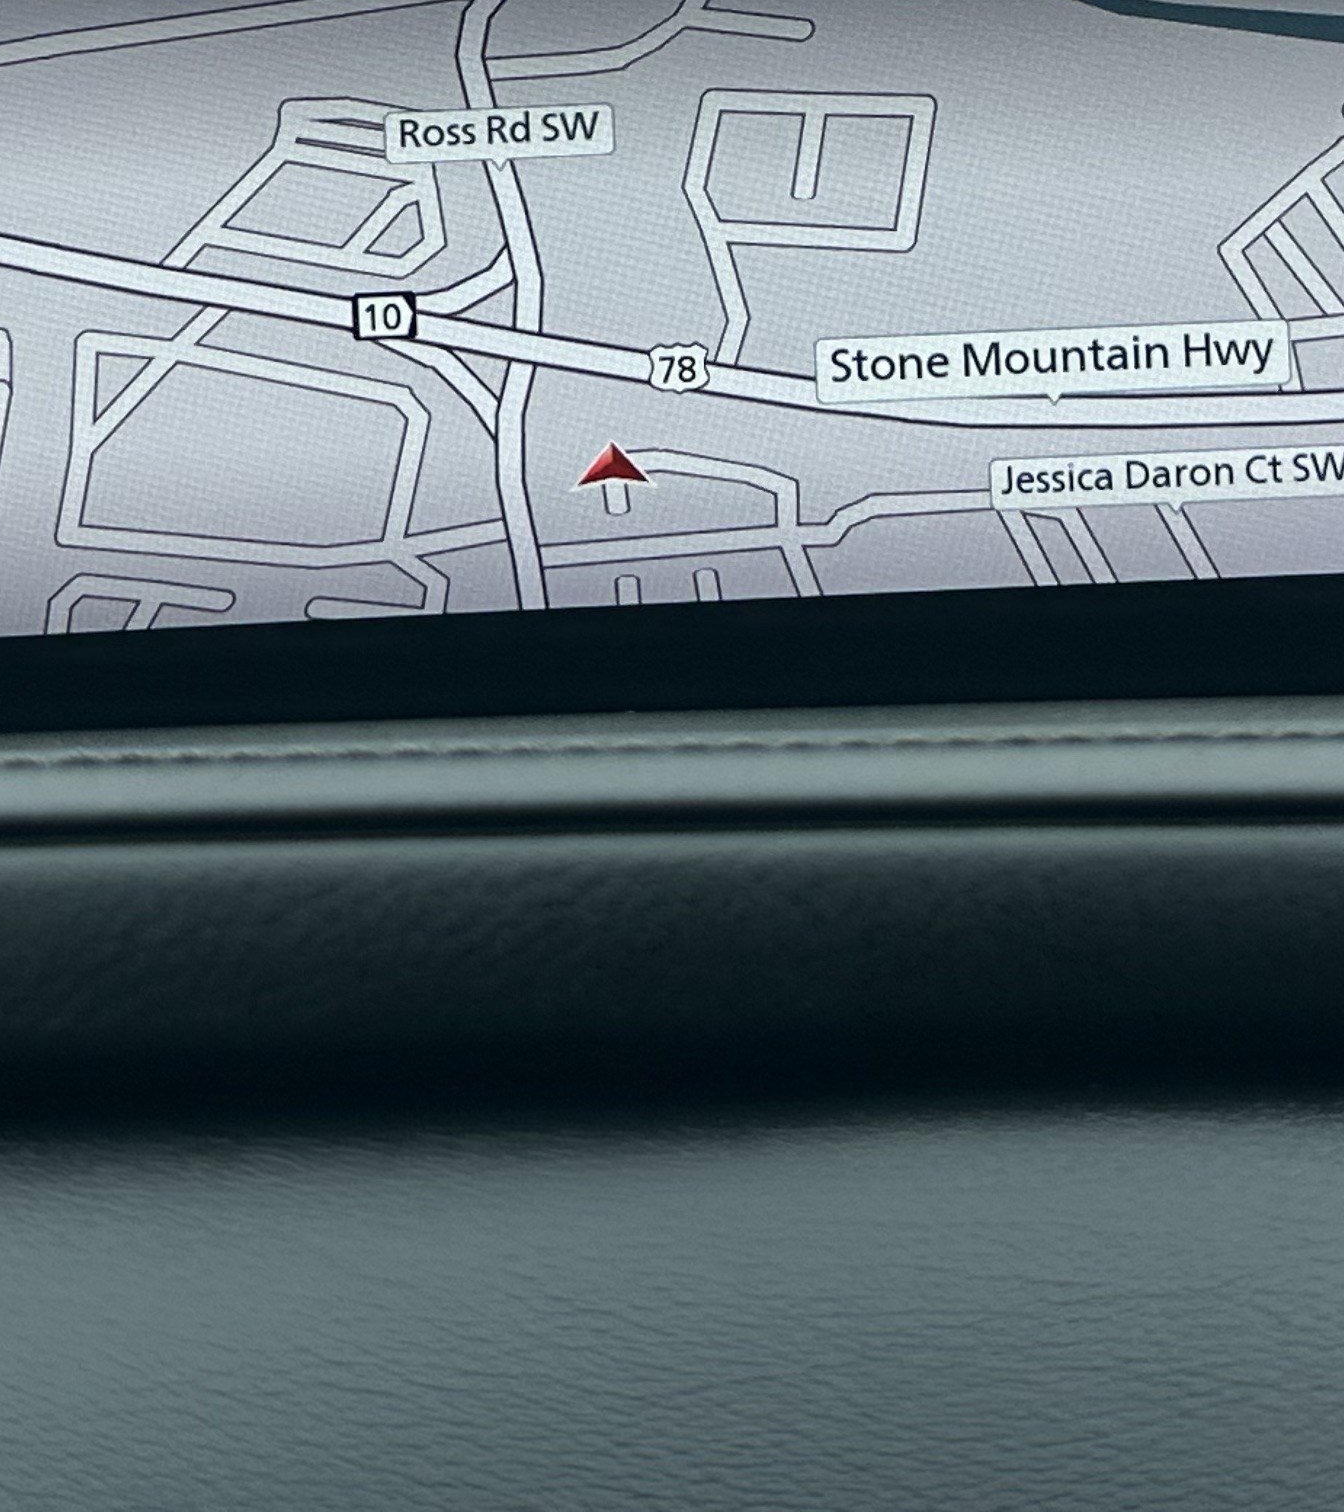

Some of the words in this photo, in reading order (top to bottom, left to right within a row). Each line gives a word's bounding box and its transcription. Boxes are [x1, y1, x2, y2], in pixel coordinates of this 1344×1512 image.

[399, 118, 476, 148] Ross
[486, 110, 531, 145] Rd
[542, 111, 599, 141] SW
[364, 303, 401, 331] 10
[657, 355, 697, 383] 78
[831, 347, 950, 383] Stone
[963, 335, 1170, 378] Mountain
[1183, 332, 1274, 375] Hwy
[1001, 464, 1114, 495] Jessica
[1126, 458, 1235, 489] Daron
[1245, 454, 1282, 484] Ct
